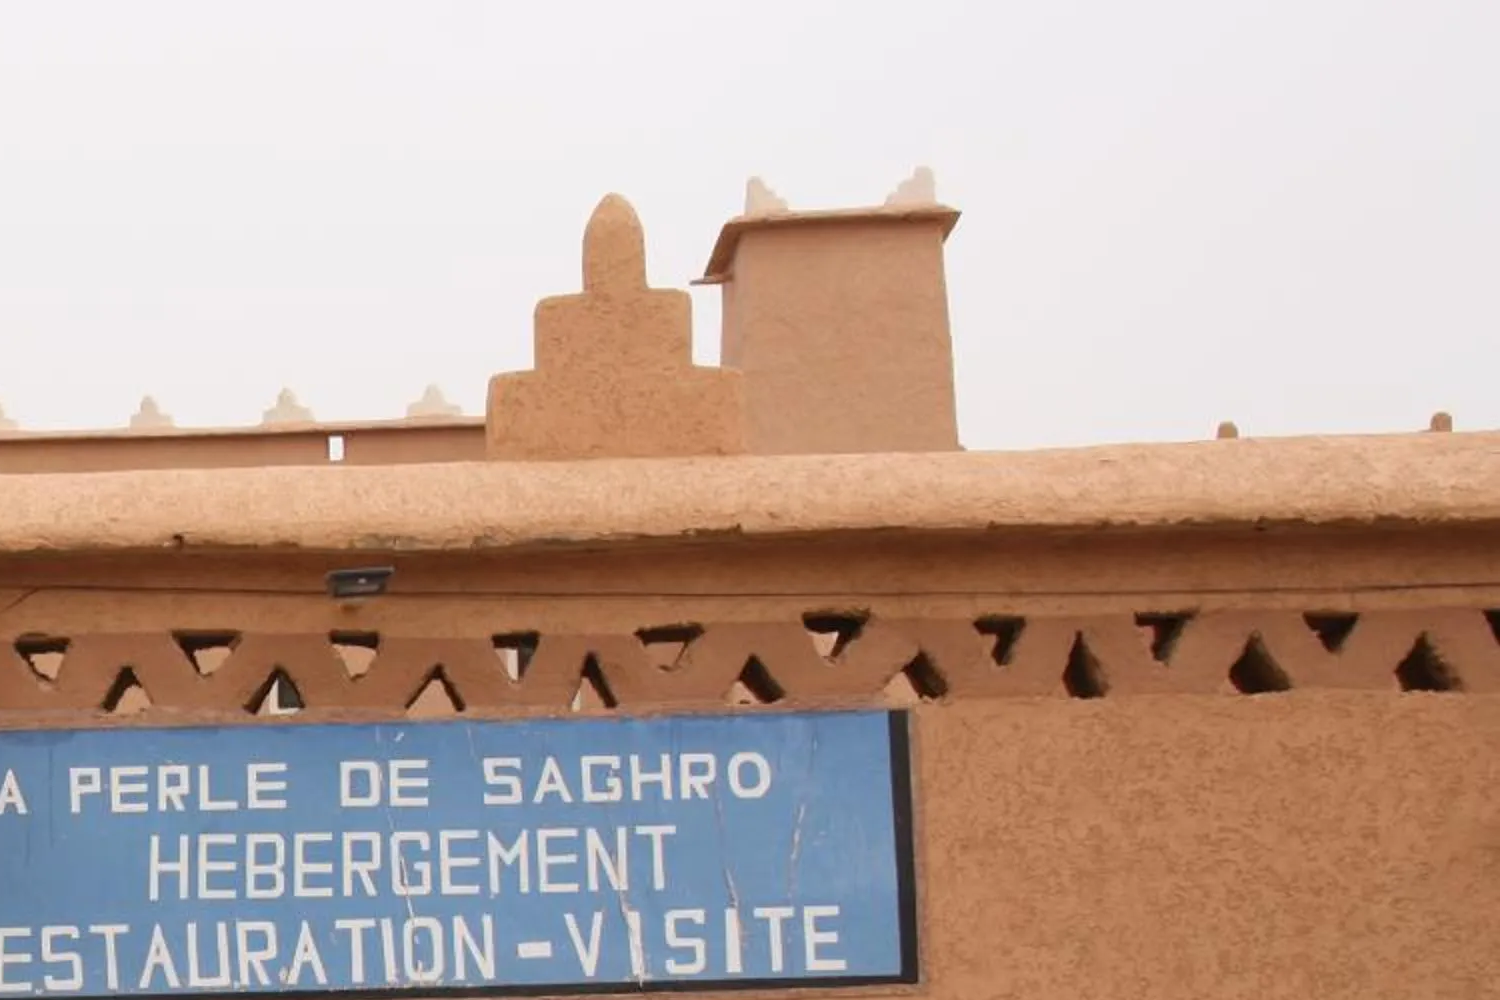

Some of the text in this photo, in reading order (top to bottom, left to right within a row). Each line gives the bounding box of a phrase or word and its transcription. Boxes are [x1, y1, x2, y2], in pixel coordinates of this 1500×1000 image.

[68, 762, 289, 814] PERLE
[340, 758, 431, 809] DE
[481, 750, 774, 807] SAGHRO
[148, 824, 677, 902] HEBERGEMENT
